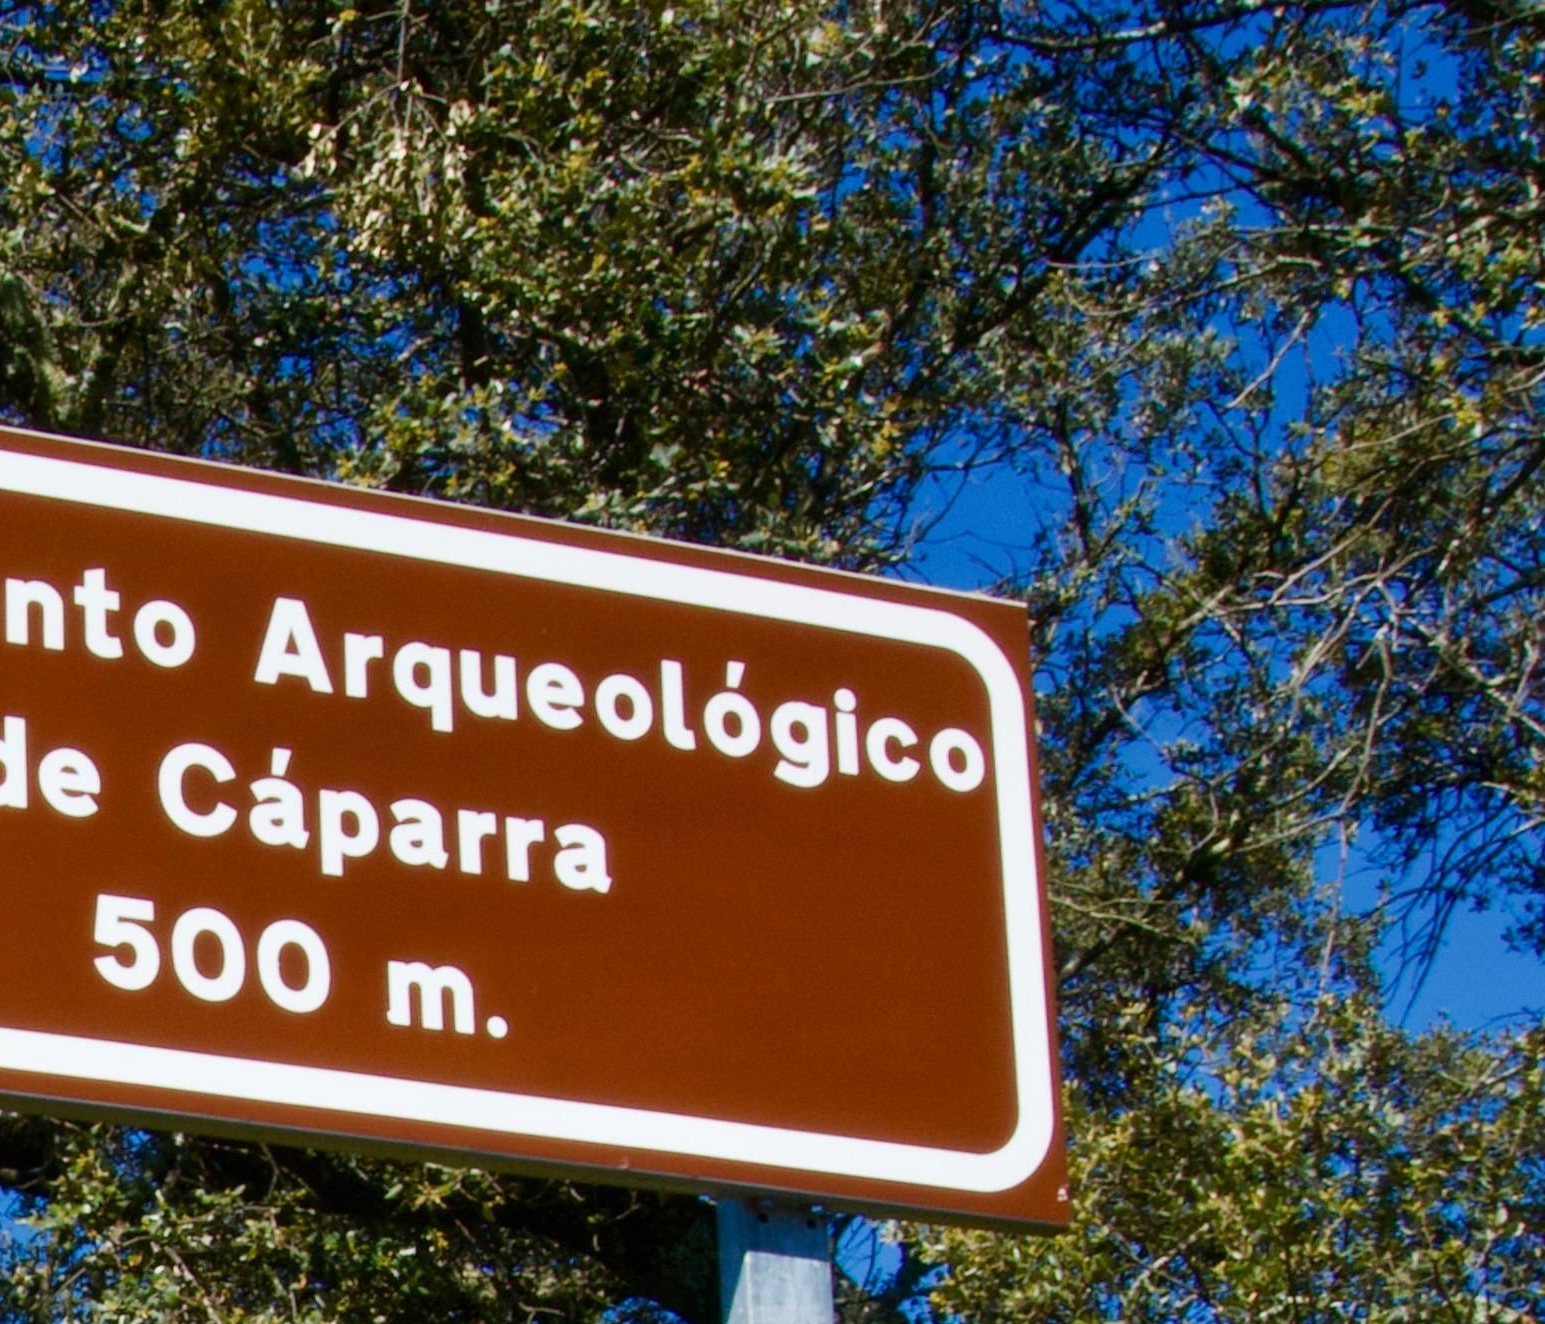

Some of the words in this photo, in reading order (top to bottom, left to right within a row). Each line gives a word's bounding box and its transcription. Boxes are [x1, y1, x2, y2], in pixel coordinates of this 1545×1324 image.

[253, 596, 986, 793] Arqueológico
[157, 741, 613, 895] Cáparra
[92, 892, 332, 1014] 500
[385, 959, 509, 1040] m.
